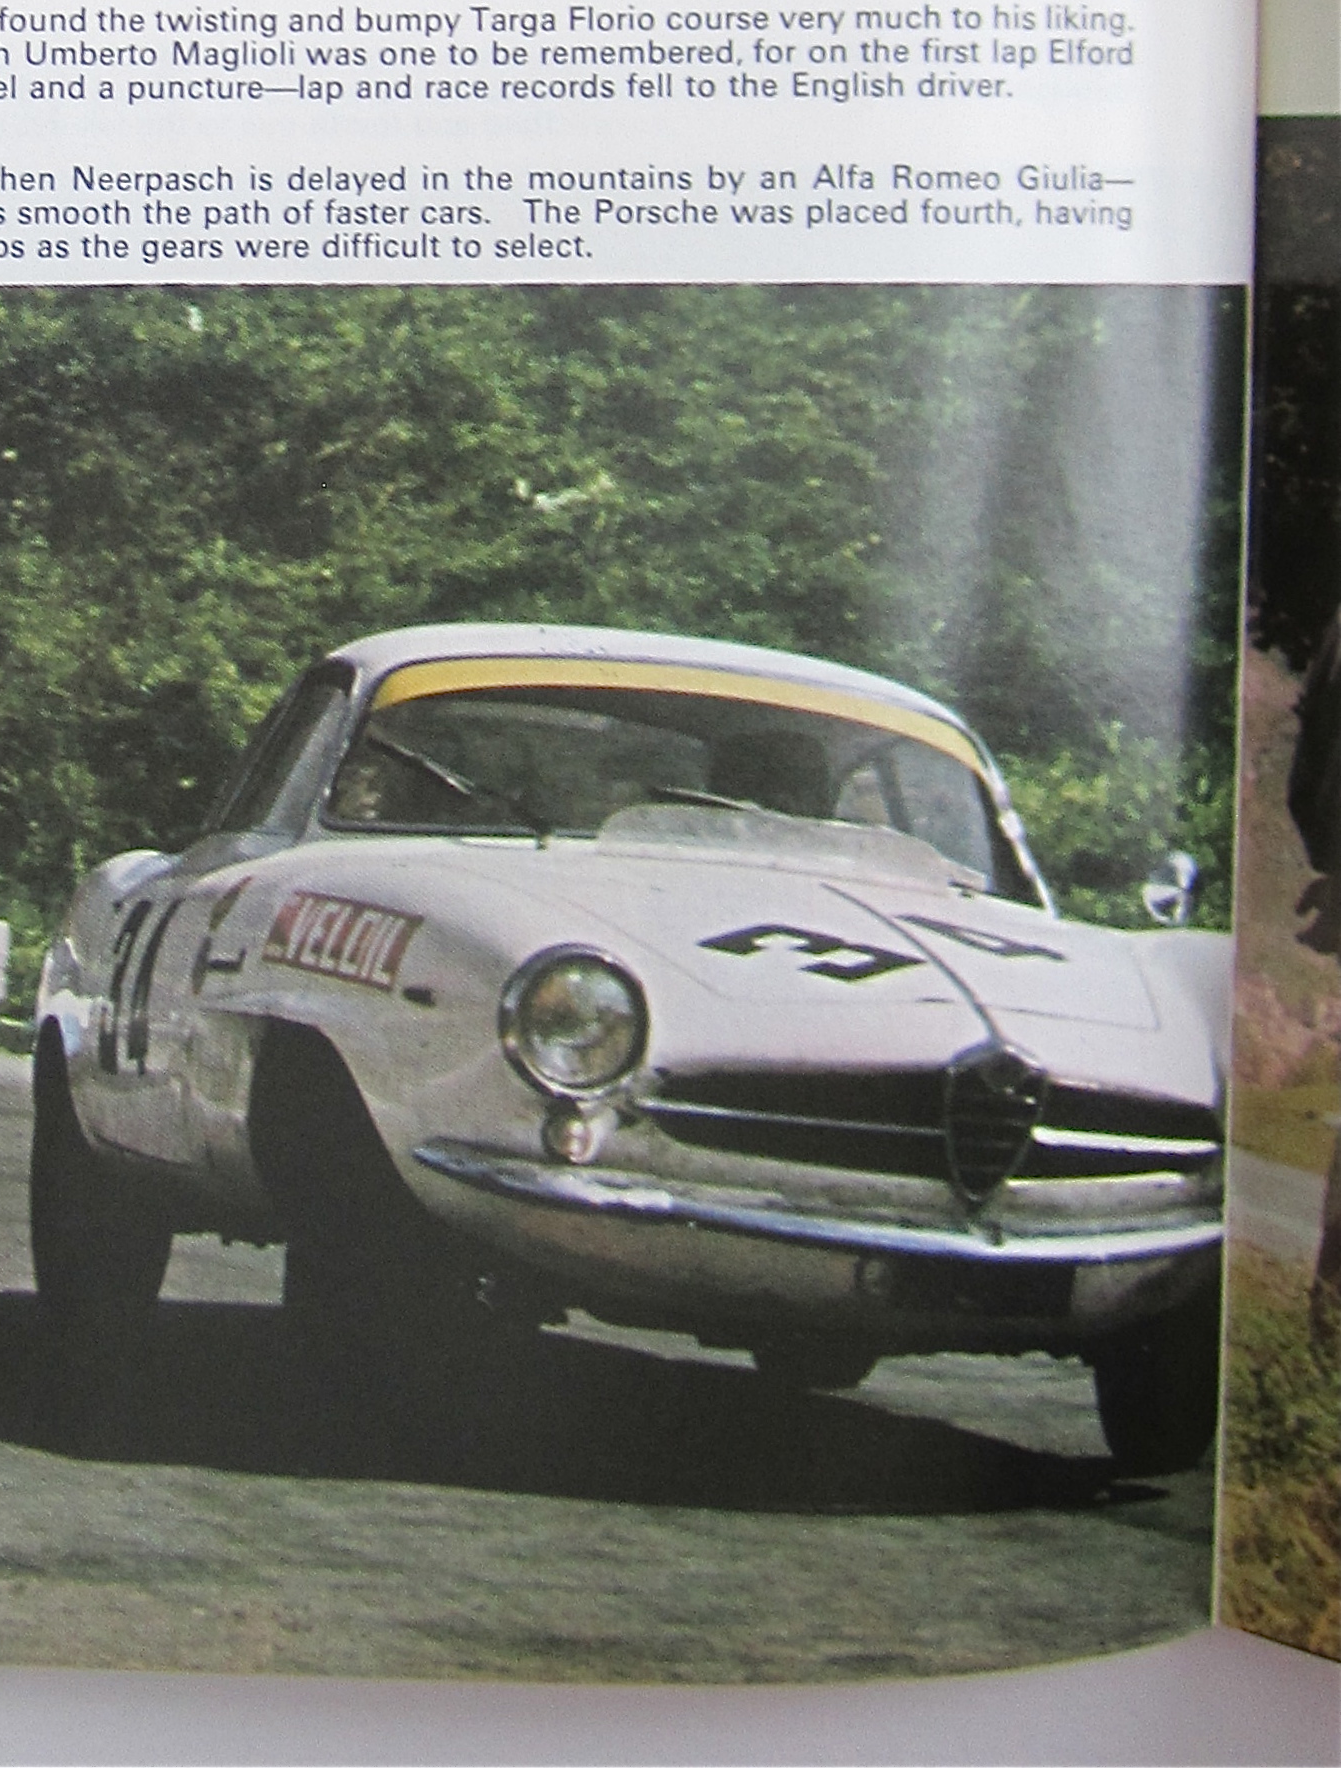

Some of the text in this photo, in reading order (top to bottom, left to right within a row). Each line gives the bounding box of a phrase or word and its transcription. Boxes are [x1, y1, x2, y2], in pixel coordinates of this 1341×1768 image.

[96, 6, 146, 34] the
[154, 5, 278, 39] twisting
[287, 6, 344, 34] and
[355, 6, 462, 38] bumpy
[469, 5, 557, 39] Targa
[568, 4, 656, 32] Florio
[665, 10, 770, 32] course
[778, 11, 845, 35] very
[855, 3, 941, 30] much
[951, 7, 982, 30] to
[993, 4, 1036, 31] his
[1046, 4, 1134, 38] liking.
[25, 40, 158, 67] Umberto
[172, 39, 296, 73] Maglioli
[305, 46, 368, 67] was
[378, 46, 437, 67] one
[447, 43, 479, 67] to
[492, 39, 529, 66] be
[540, 38, 743, 67] remembered,
[752, 37, 797, 65] for
[807, 44, 848, 65] on
[859, 38, 910, 64] the
[921, 37, 980, 65] first
[992, 38, 1037, 70] lap
[1049, 38, 1133, 66] Elford
[29, 73, 86, 101] and
[98, 80, 115, 100] a
[355, 73, 412, 100] and
[425, 79, 490, 100] race
[501, 72, 616, 100] records
[625, 71, 673, 99] fell
[684, 75, 717, 99] to
[727, 71, 779, 98] the
[792, 71, 905, 104] English
[917, 71, 1013, 98] driver.
[72, 164, 234, 198] Neerpasch
[249, 164, 274, 192] is
[286, 165, 407, 197] delayed
[422, 164, 450, 191] in
[463, 165, 513, 192] the
[528, 163, 693, 191] mountains
[707, 164, 746, 196] by
[759, 170, 797, 191] an
[812, 163, 875, 191] Alfa
[892, 163, 1001, 191] Romeo
[16, 198, 131, 226] smooth
[142, 198, 192, 226] the
[203, 198, 271, 231] path
[282, 198, 315, 226] of
[323, 197, 411, 226] faster
[420, 205, 491, 226] cars.
[522, 197, 581, 225] The
[594, 197, 719, 225] Porsche
[729, 204, 794, 225] was
[806, 197, 908, 230] placed
[920, 197, 1022, 227] fourth,
[1035, 199, 1132, 231] having
[36, 239, 71, 260] as
[79, 232, 130, 259] the
[141, 238, 224, 265] gears
[234, 238, 310, 259] were
[321, 231, 442, 259] difficult
[450, 235, 482, 259] to
[493, 231, 593, 259] select.
[695, 913, 1068, 983] 34
